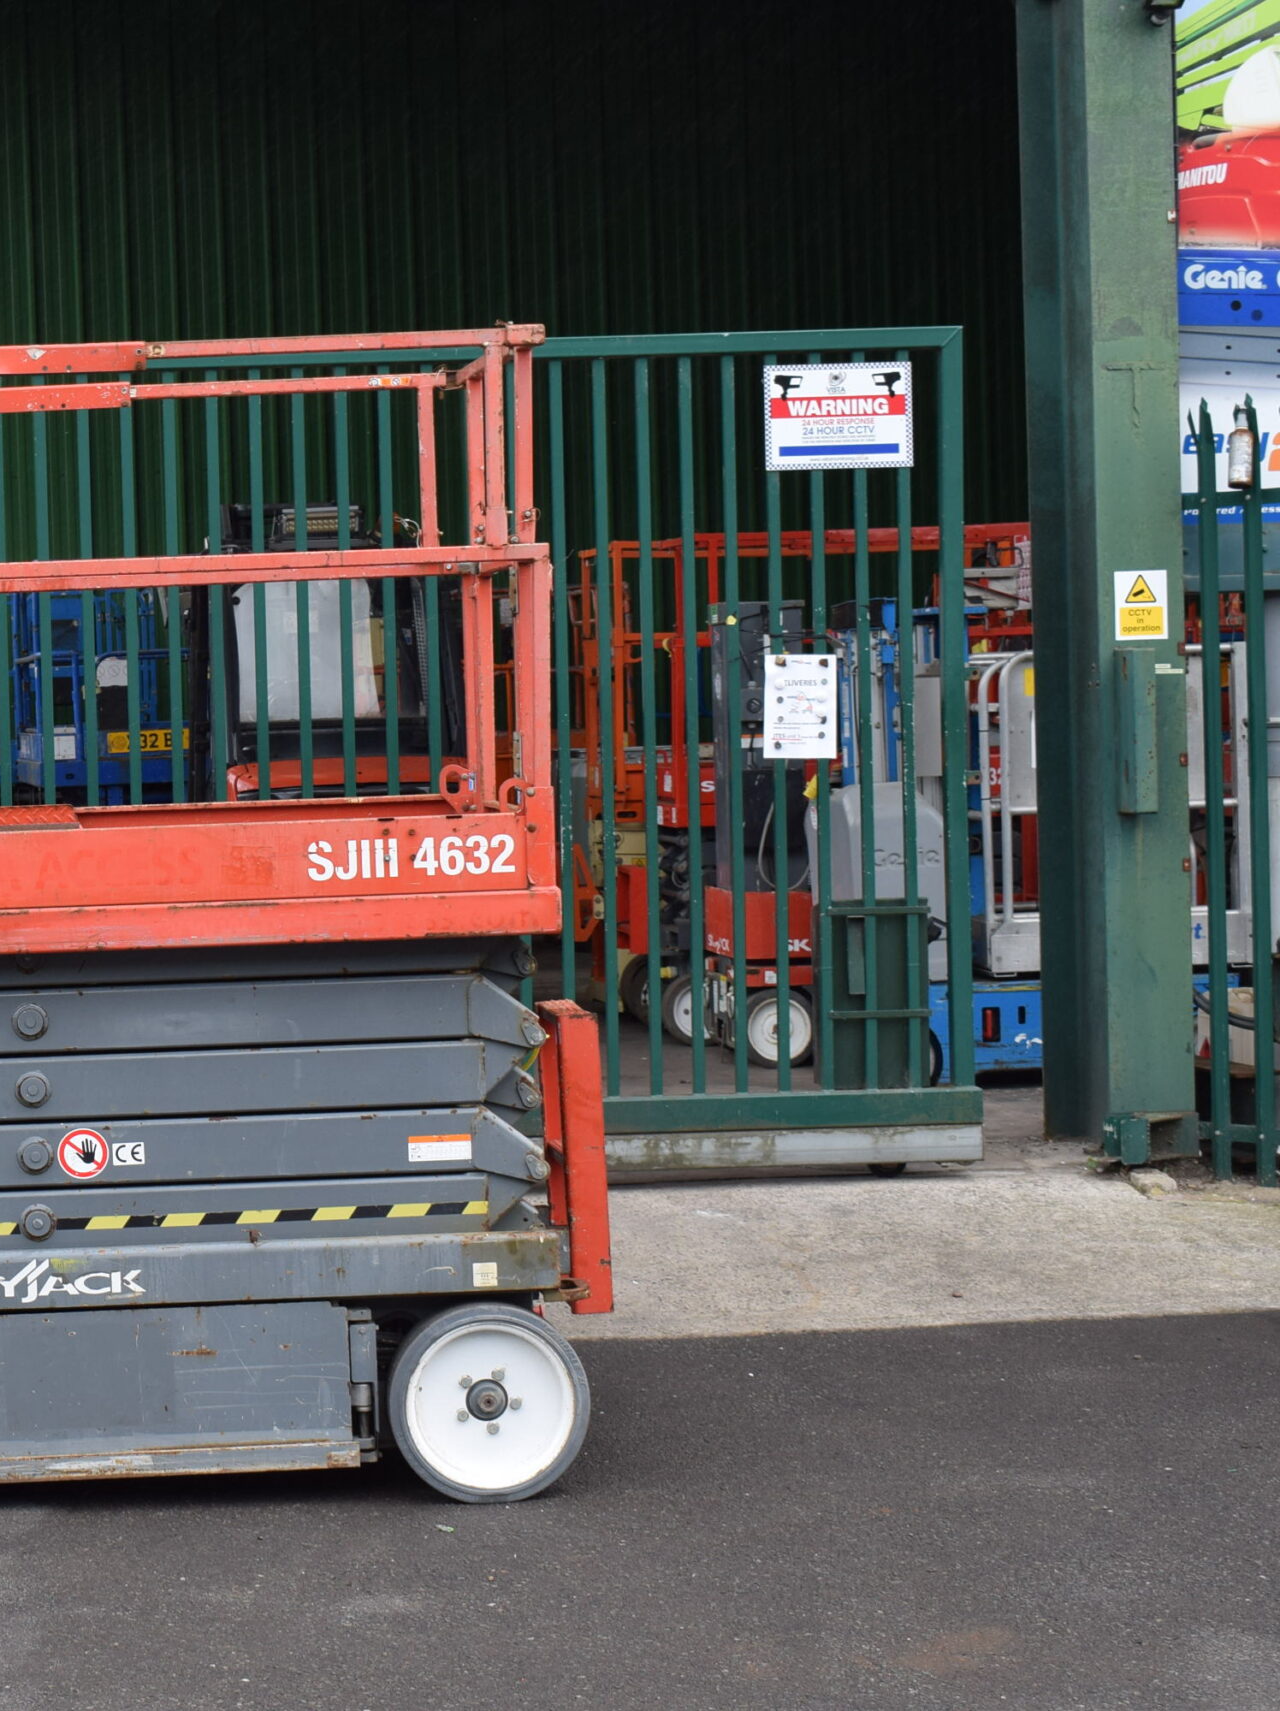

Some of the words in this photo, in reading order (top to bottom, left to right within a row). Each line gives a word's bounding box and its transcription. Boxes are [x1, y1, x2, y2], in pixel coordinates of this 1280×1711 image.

[1184, 264, 1264, 289] Genie
[787, 397, 890, 416] WARNING
[812, 418, 834, 426] HOUR
[836, 417, 875, 425] RESPONSE
[802, 427, 814, 435] 24
[816, 426, 845, 435] HOUR
[847, 425, 875, 434] CCTV
[1128, 609, 1152, 617] CCTV
[1122, 625, 1161, 634] operation
[413, 834, 516, 876] 4632
[115, 1143, 143, 1163] CE
